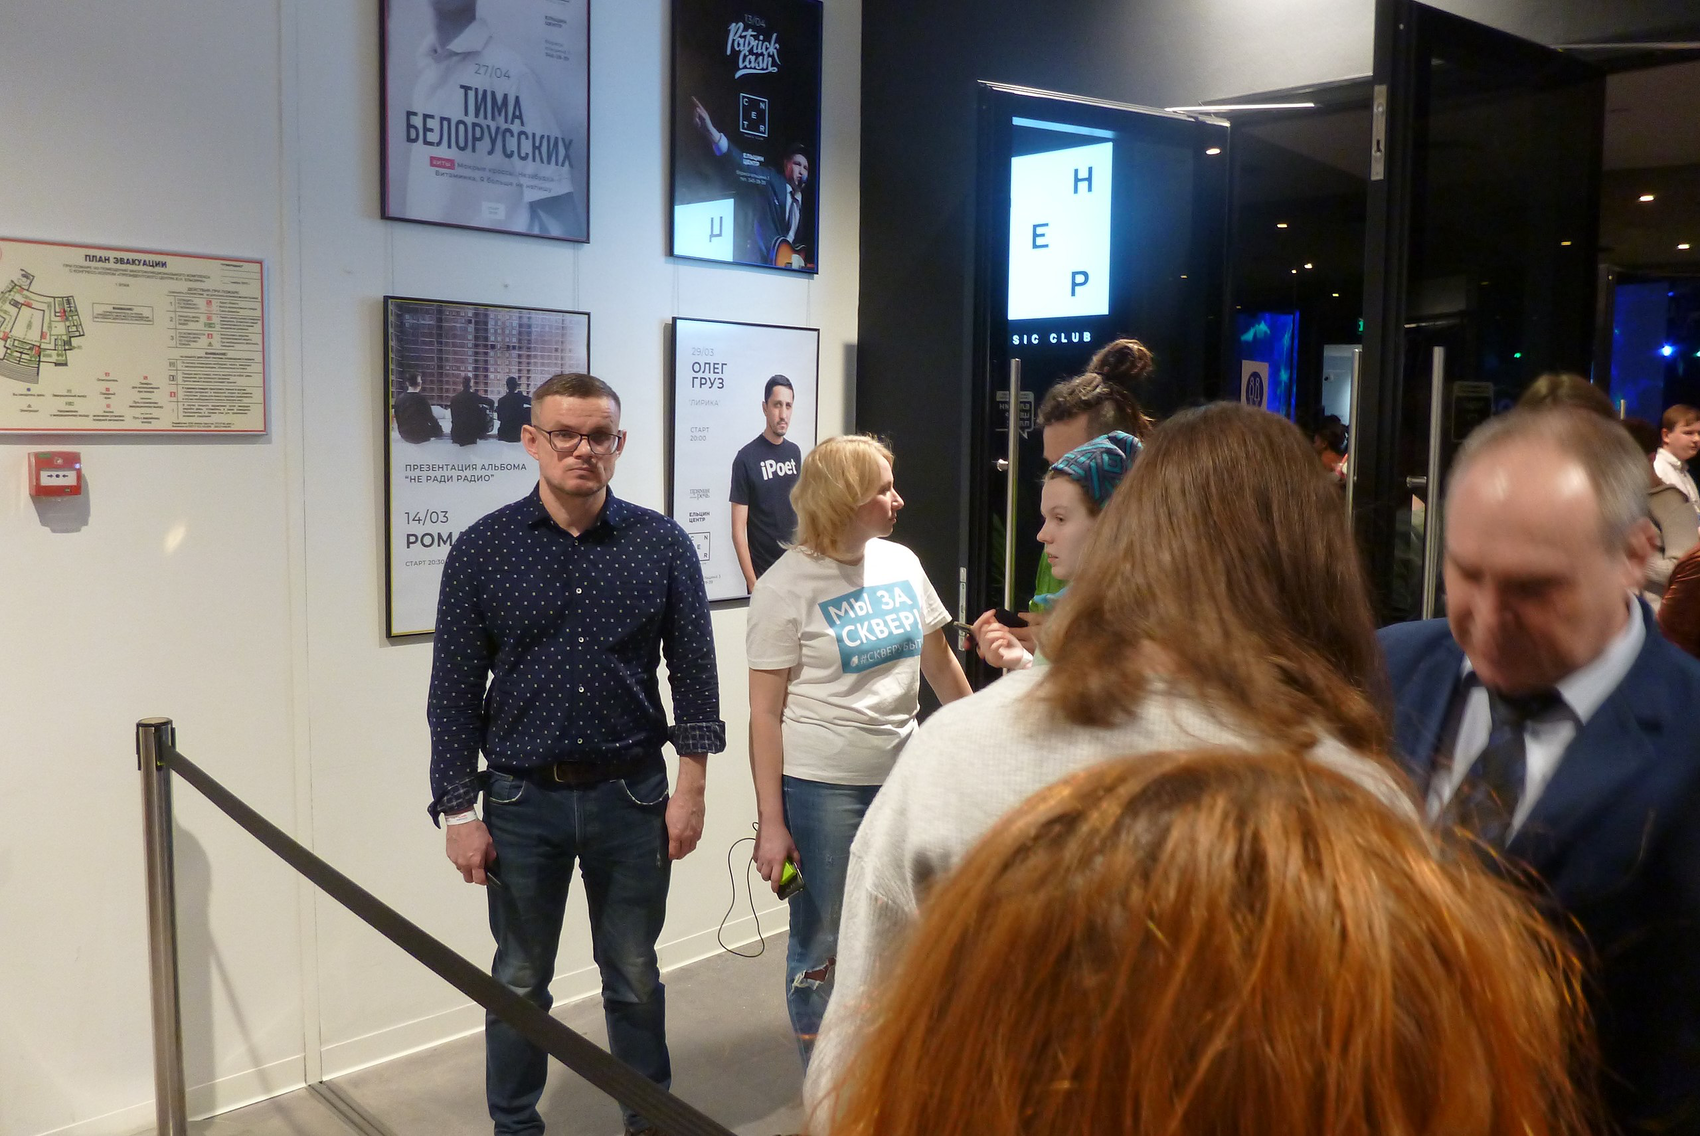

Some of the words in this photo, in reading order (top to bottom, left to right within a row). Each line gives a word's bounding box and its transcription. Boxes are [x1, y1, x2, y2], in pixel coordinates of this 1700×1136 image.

[726, 22, 781, 64] Patrick
[737, 50, 777, 76] Cash
[474, 63, 511, 80] 27/04
[459, 84, 525, 127] ТИМА
[405, 110, 575, 169] БЕЛОРУССКИХ
[84, 254, 110, 264] ПЛАН
[113, 257, 167, 268] ЭВАКУАЦИИ
[1049, 331, 1091, 344] CLUB
[691, 347, 714, 357] 29/03
[691, 361, 727, 375] ОЛЕГ
[691, 376, 725, 390] ГРУЗ
[690, 426, 710, 434] СТАРТ
[405, 463, 478, 472] ПРЕЗЕНТАЦИЯ
[480, 463, 527, 471] АЛЬБОМА
[760, 458, 797, 481] iPoet
[426, 475, 453, 483] РАДИ
[404, 509, 449, 525] 14/03
[828, 592, 873, 625] МЫ
[876, 586, 913, 610] ЗА
